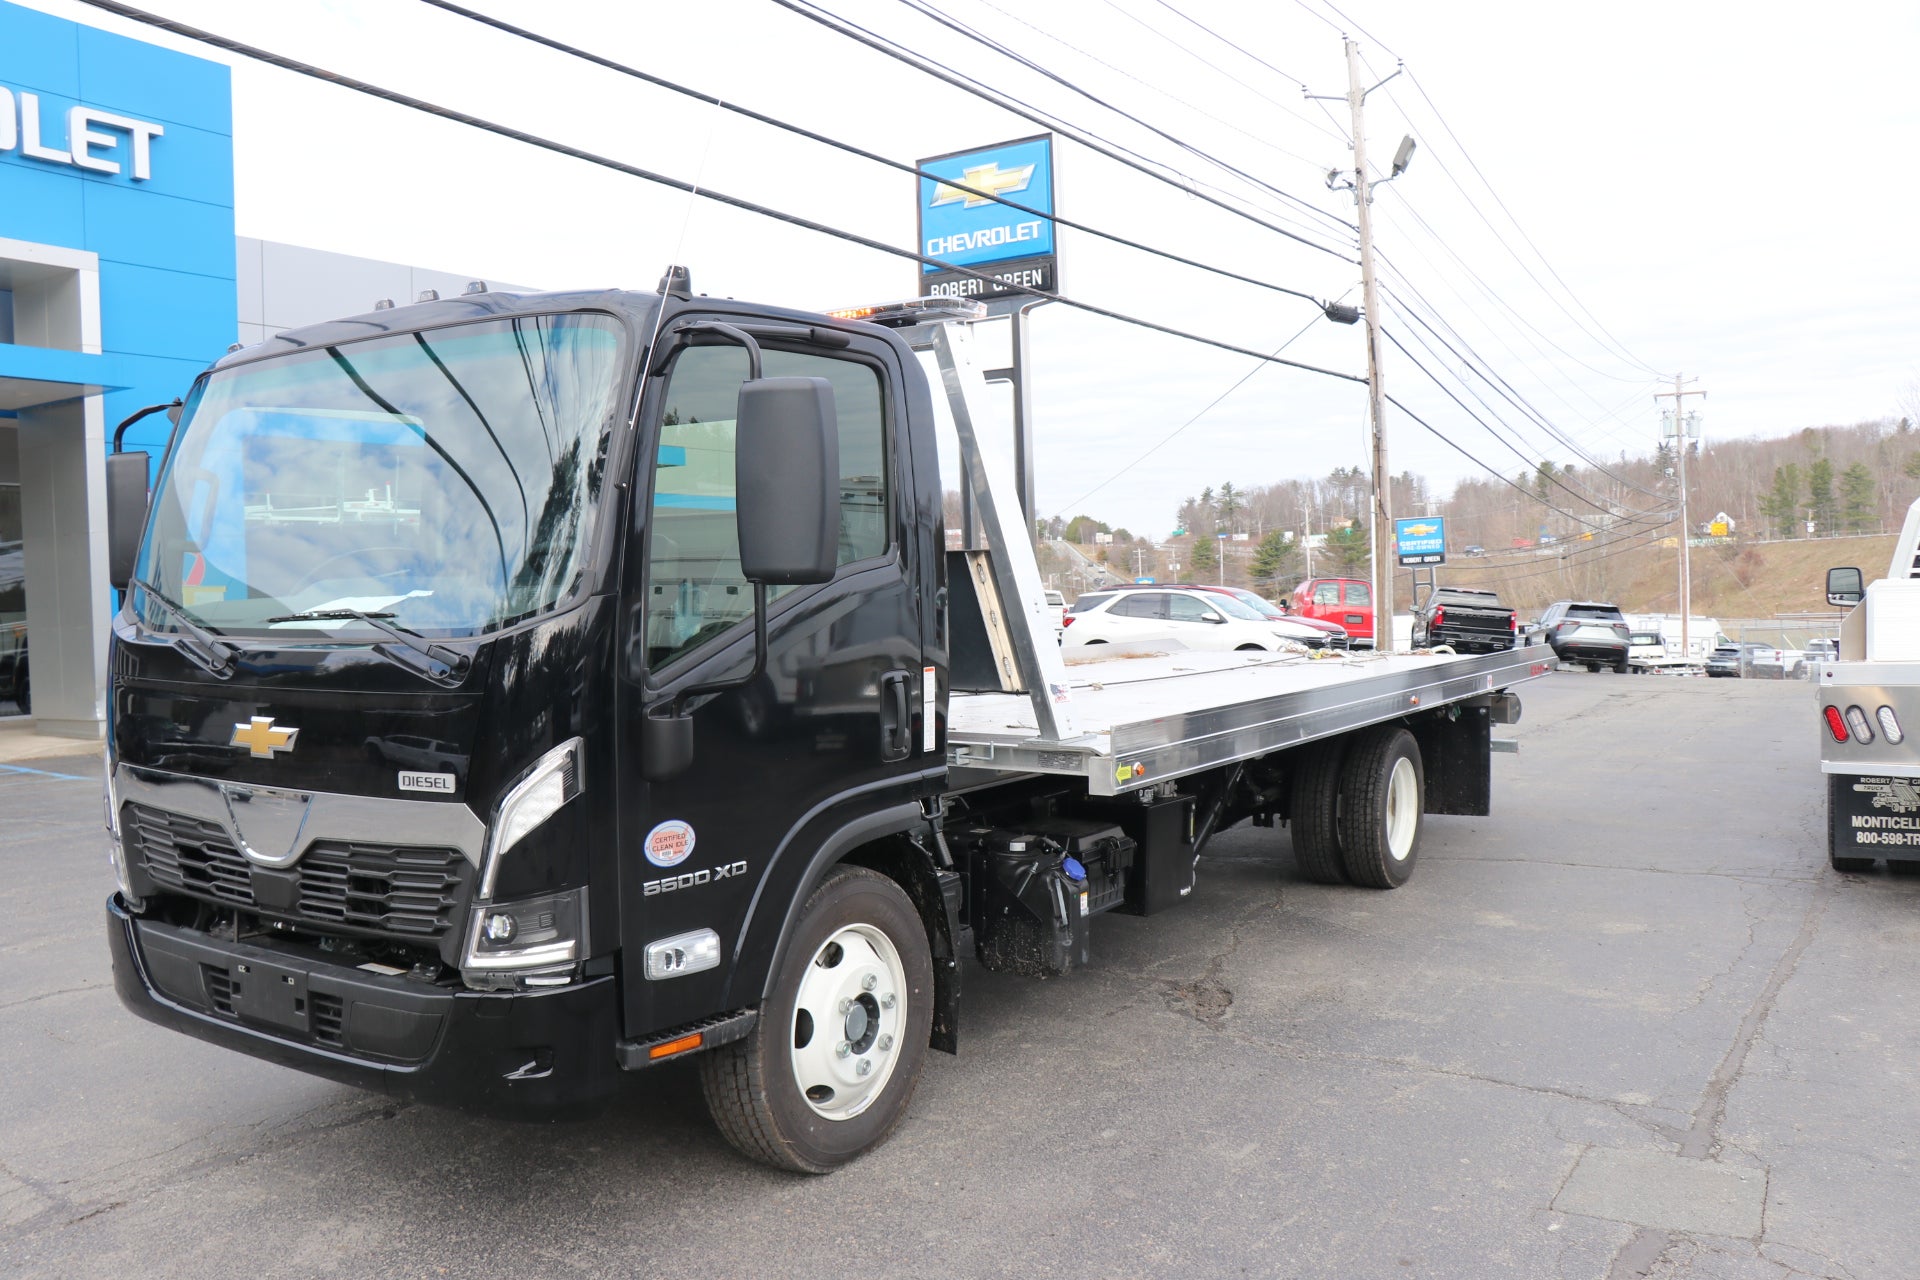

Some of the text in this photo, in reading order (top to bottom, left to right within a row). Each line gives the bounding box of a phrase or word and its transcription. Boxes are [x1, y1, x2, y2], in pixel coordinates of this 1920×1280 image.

[927, 221, 1042, 256] CHEVROLET
[930, 278, 984, 298] ROBERT
[1402, 555, 1441, 564] ROBERT GREEN
[402, 775, 451, 790] DIESEL
[652, 843, 674, 852] CLEAN
[676, 839, 689, 848] IDLE
[654, 833, 687, 844] CERTIFIED
[643, 860, 748, 897] 5500 XD
